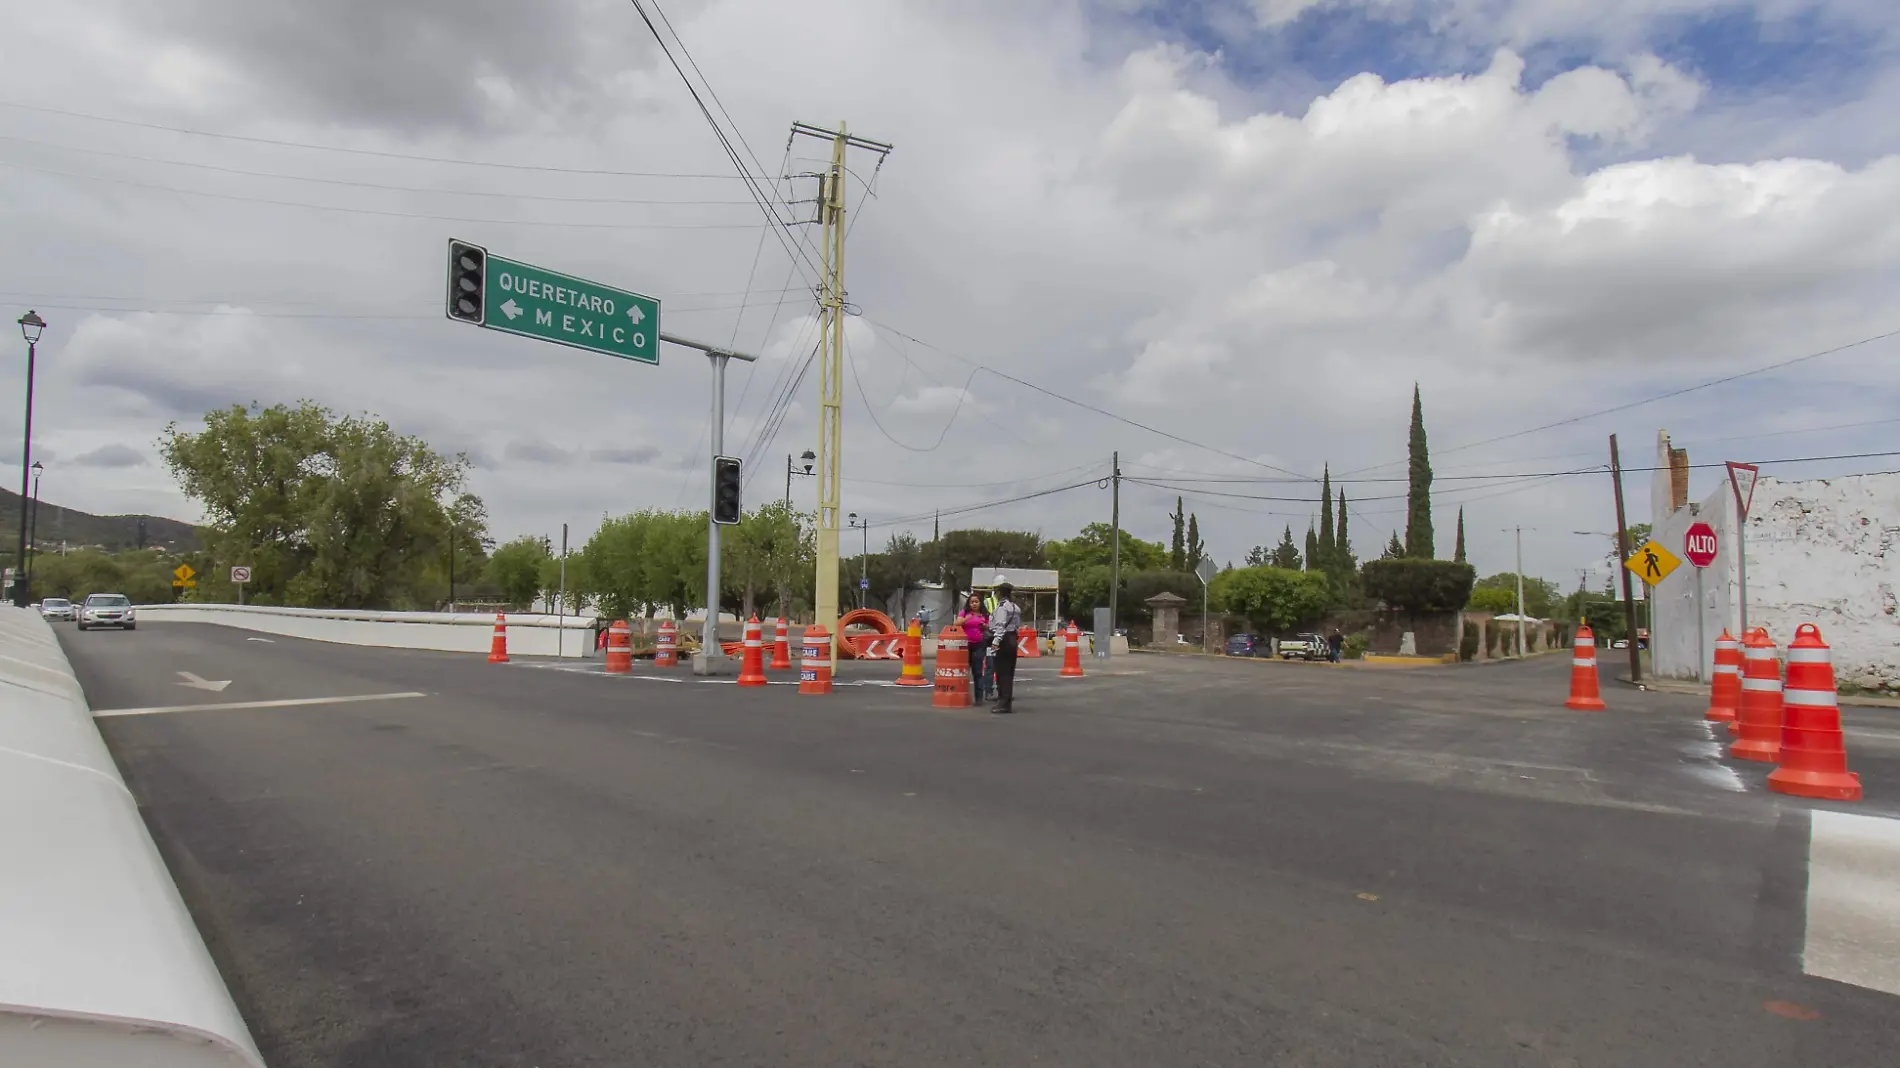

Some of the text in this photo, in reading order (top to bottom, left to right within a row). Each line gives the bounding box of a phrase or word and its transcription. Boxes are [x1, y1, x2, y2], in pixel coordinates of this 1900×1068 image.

[499, 272, 615, 316] QUERETARO
[535, 308, 646, 348] MEXICO
[1688, 535, 1716, 554] ALTO
